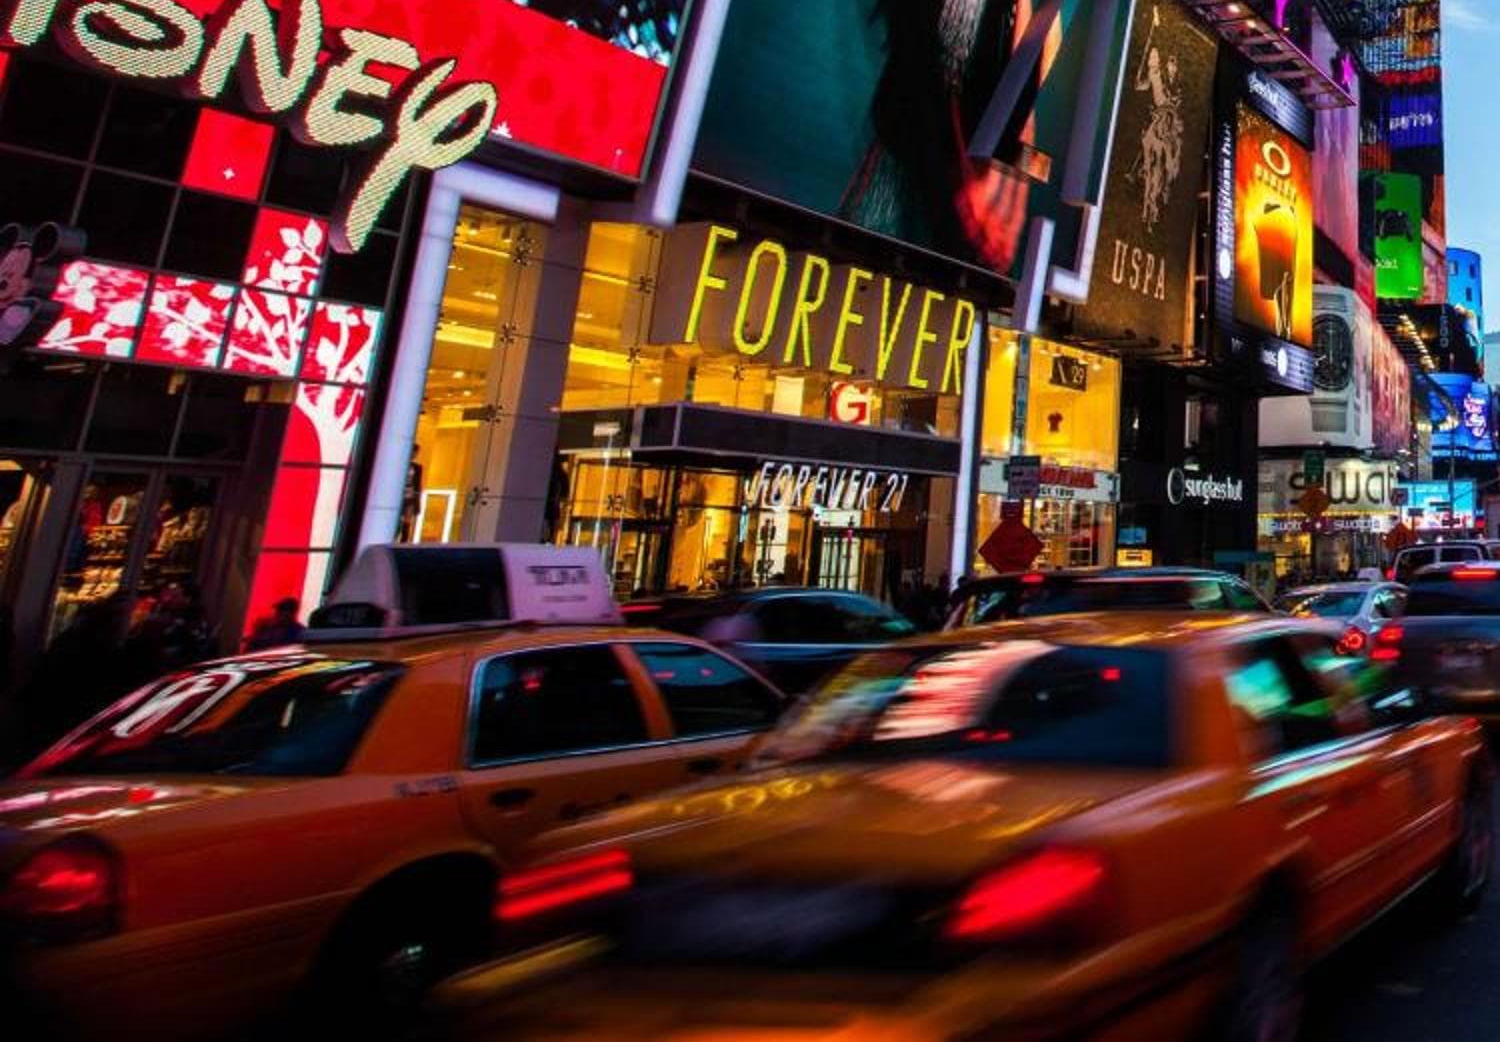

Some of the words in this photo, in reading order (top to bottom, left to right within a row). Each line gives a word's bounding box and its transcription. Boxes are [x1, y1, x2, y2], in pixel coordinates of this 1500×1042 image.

[1110, 239, 1165, 300] USPA
[683, 224, 976, 396] FOREVER
[755, 461, 877, 511] FOREVER
[880, 473, 908, 512] 21
